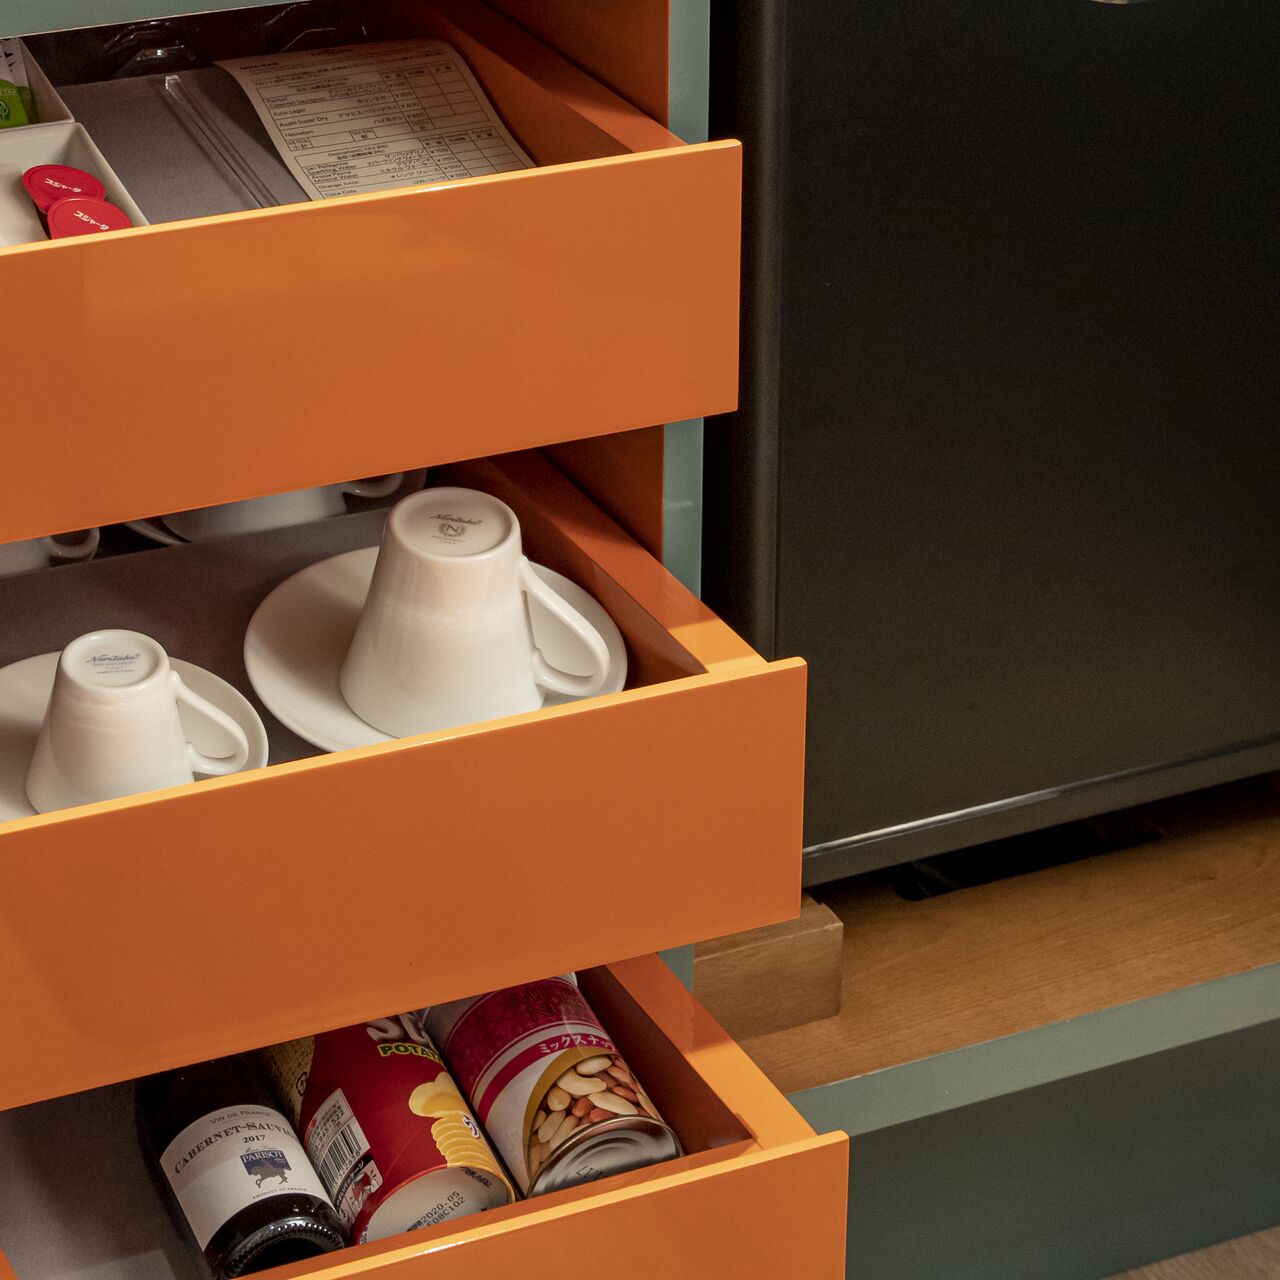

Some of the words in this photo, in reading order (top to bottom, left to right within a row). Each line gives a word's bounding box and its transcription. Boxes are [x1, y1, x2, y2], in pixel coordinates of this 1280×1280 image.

[377, 1042, 441, 1062] POTAT
[242, 1134, 266, 1143] 2017
[242, 1150, 283, 1163] PARISOT
